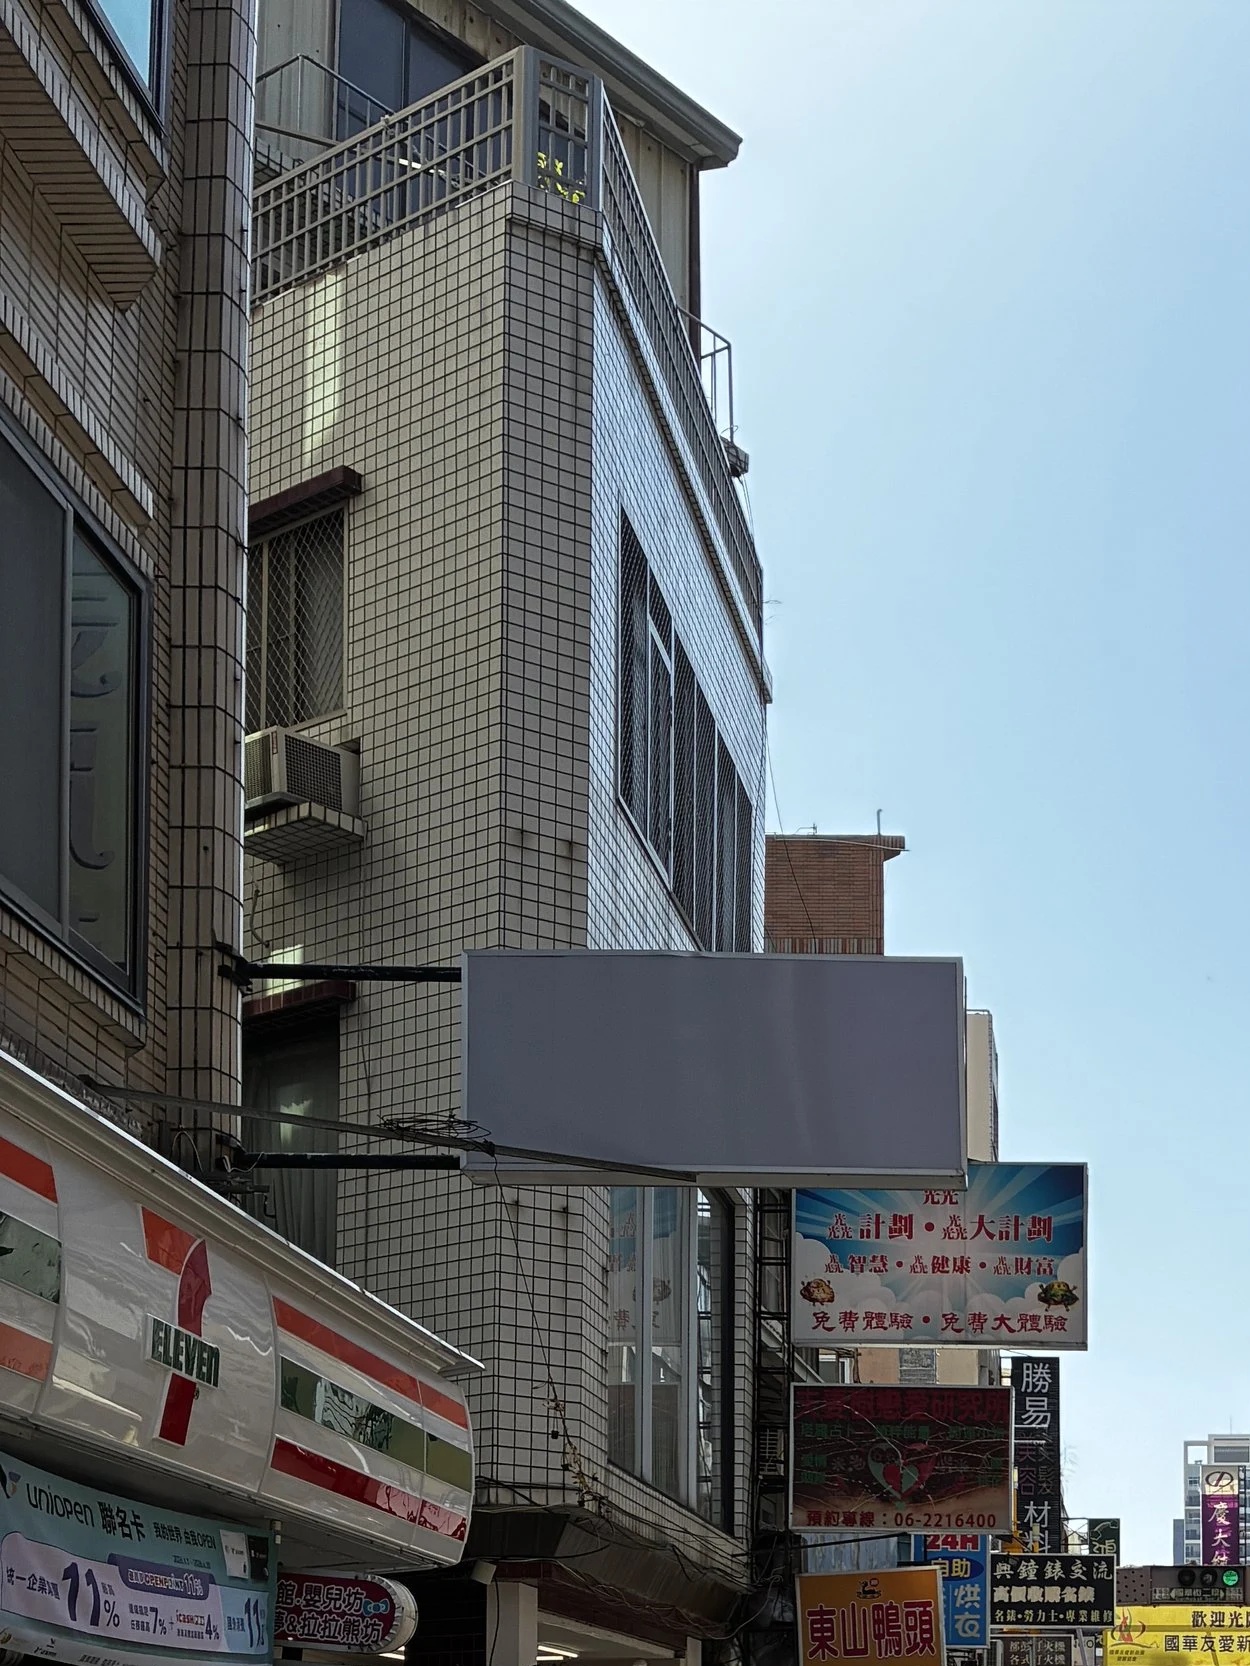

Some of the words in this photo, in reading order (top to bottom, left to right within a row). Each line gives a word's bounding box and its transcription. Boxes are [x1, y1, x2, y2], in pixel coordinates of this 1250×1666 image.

[1020, 1362, 1052, 1427] 勝易
[26, 1483, 95, 1528] uniopen
[97, 1500, 146, 1542] 聯名卡
[931, 1558, 971, 1578] 自助
[806, 1600, 937, 1663] 東山鴨頭
[953, 1584, 981, 1639] 烘衣
